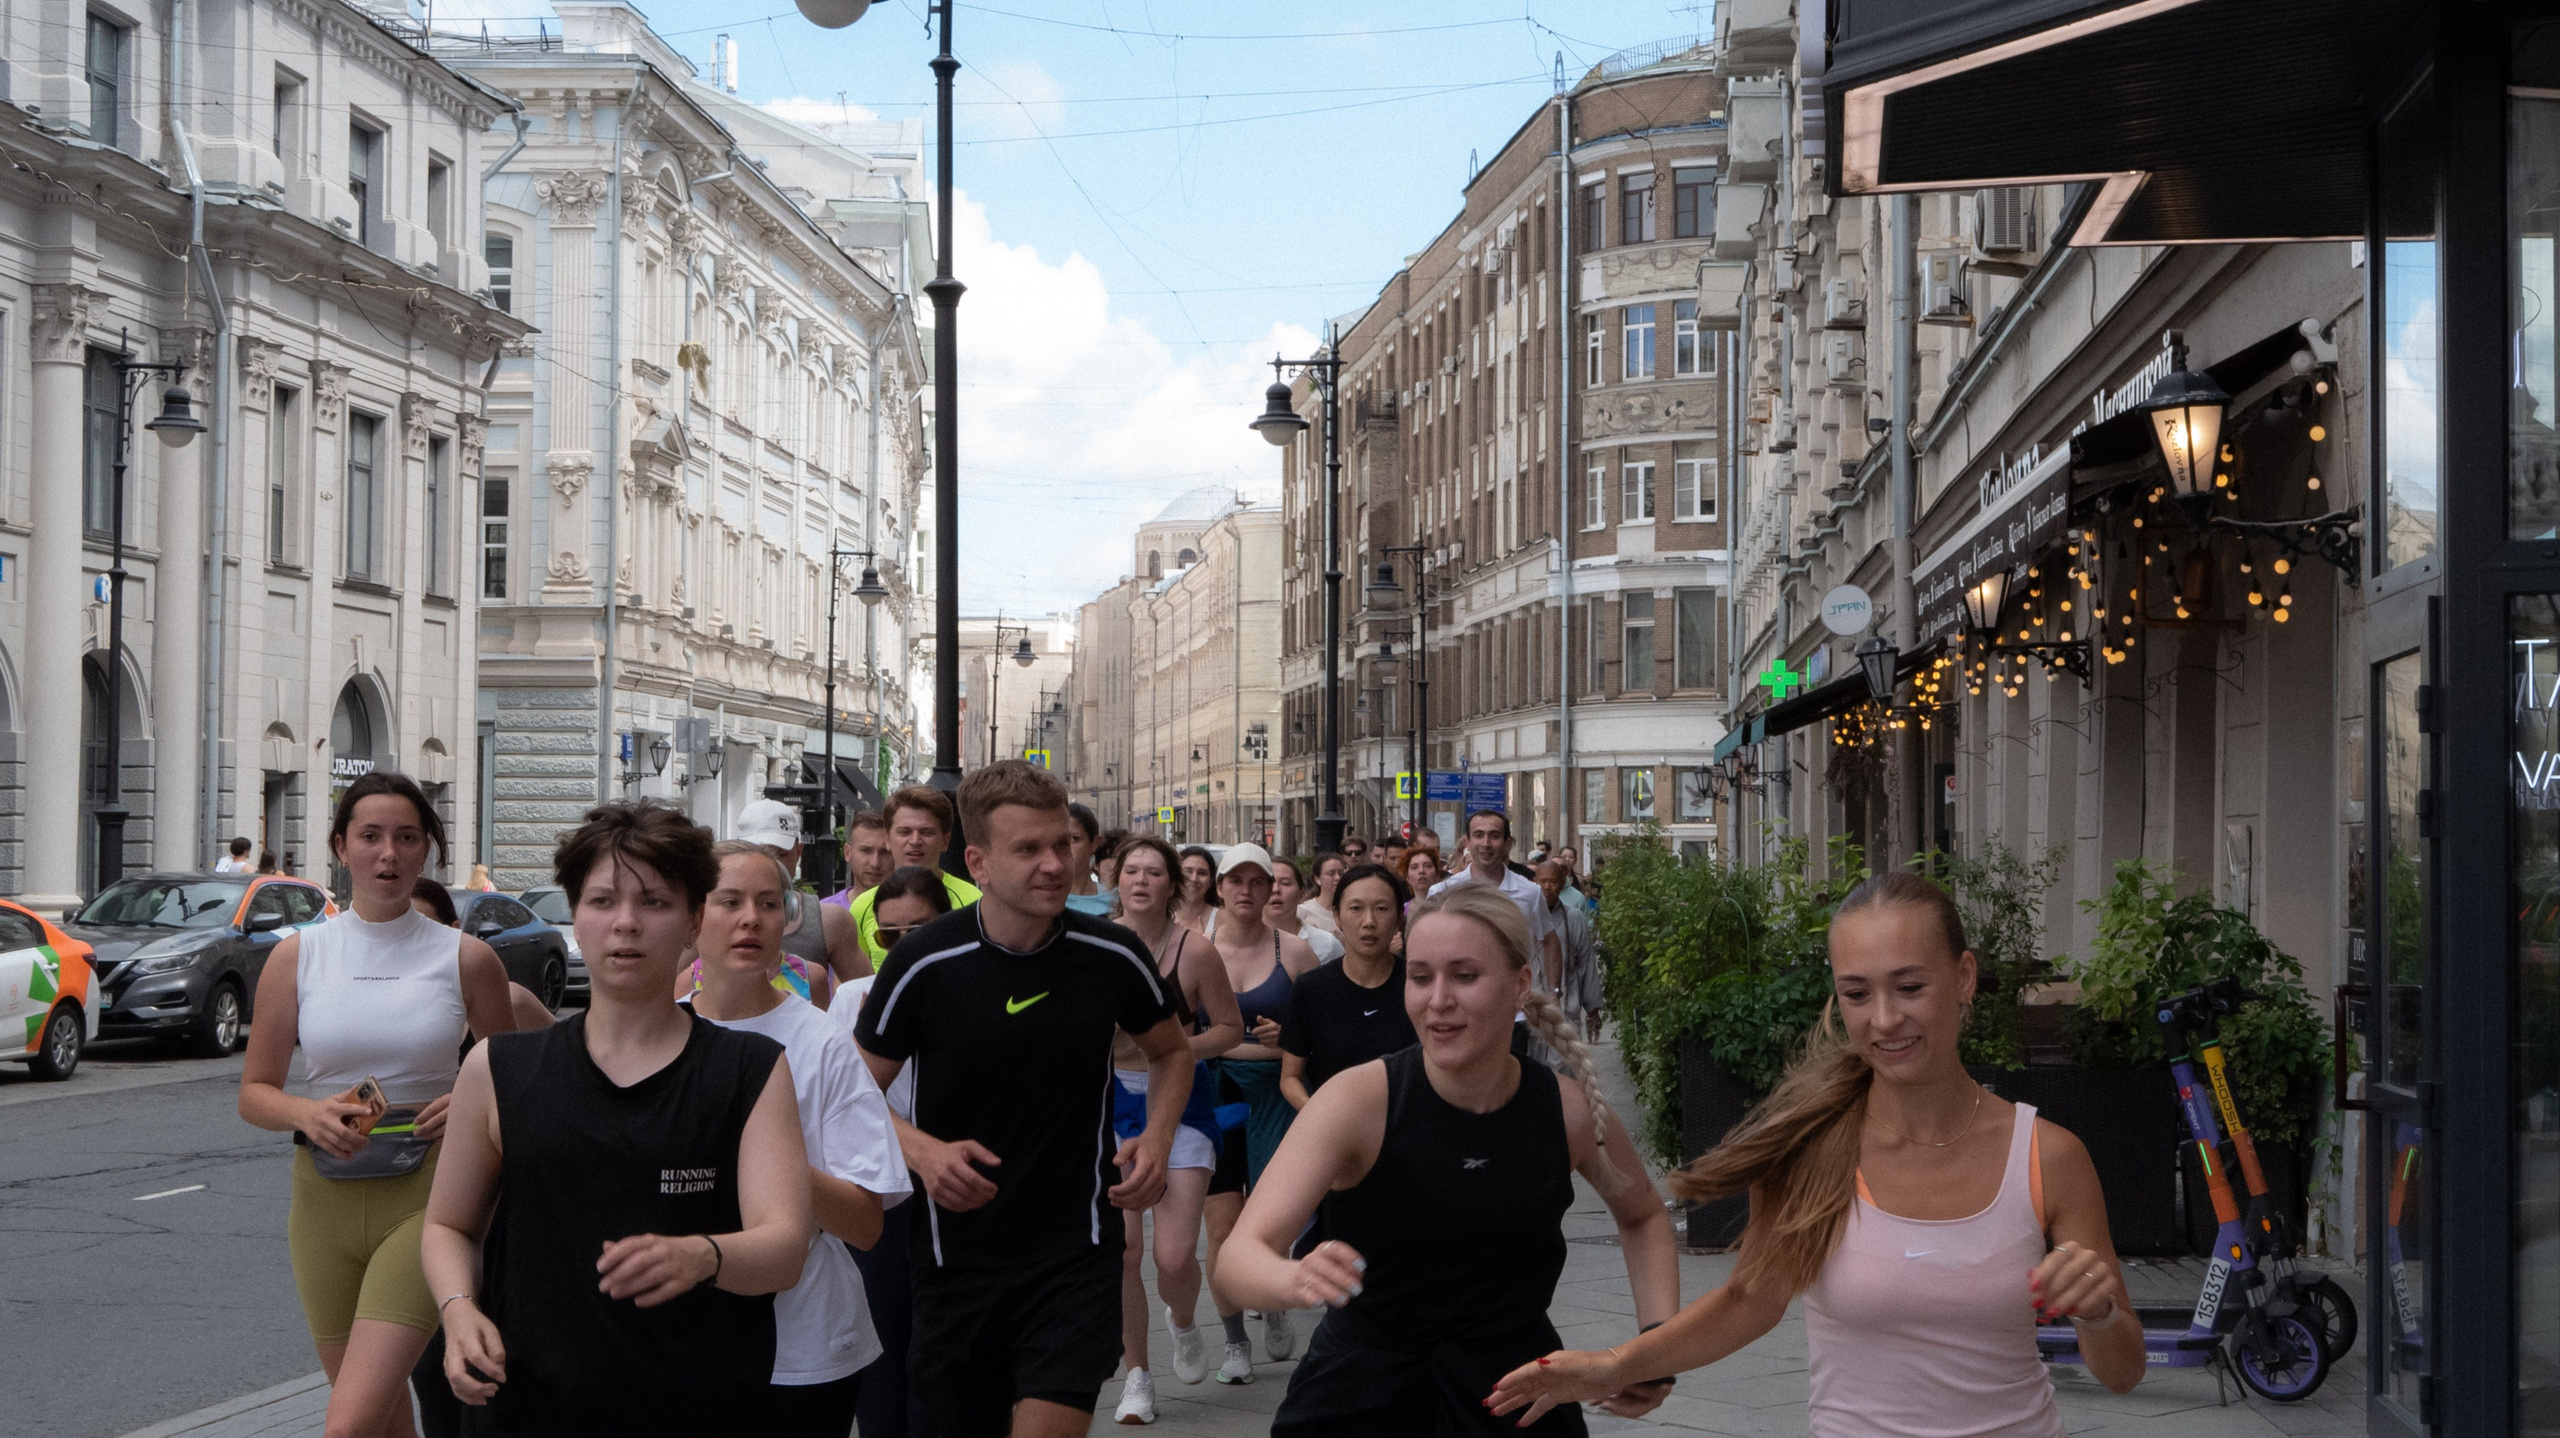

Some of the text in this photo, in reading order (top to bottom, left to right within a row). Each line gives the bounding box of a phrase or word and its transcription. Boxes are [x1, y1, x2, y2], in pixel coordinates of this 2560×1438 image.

[2211, 1065, 2240, 1133] WHOOSH
[660, 1168, 716, 1181] RUNNING
[660, 1180, 715, 1194] RELIGION
[2198, 1263, 2228, 1320] 158312
